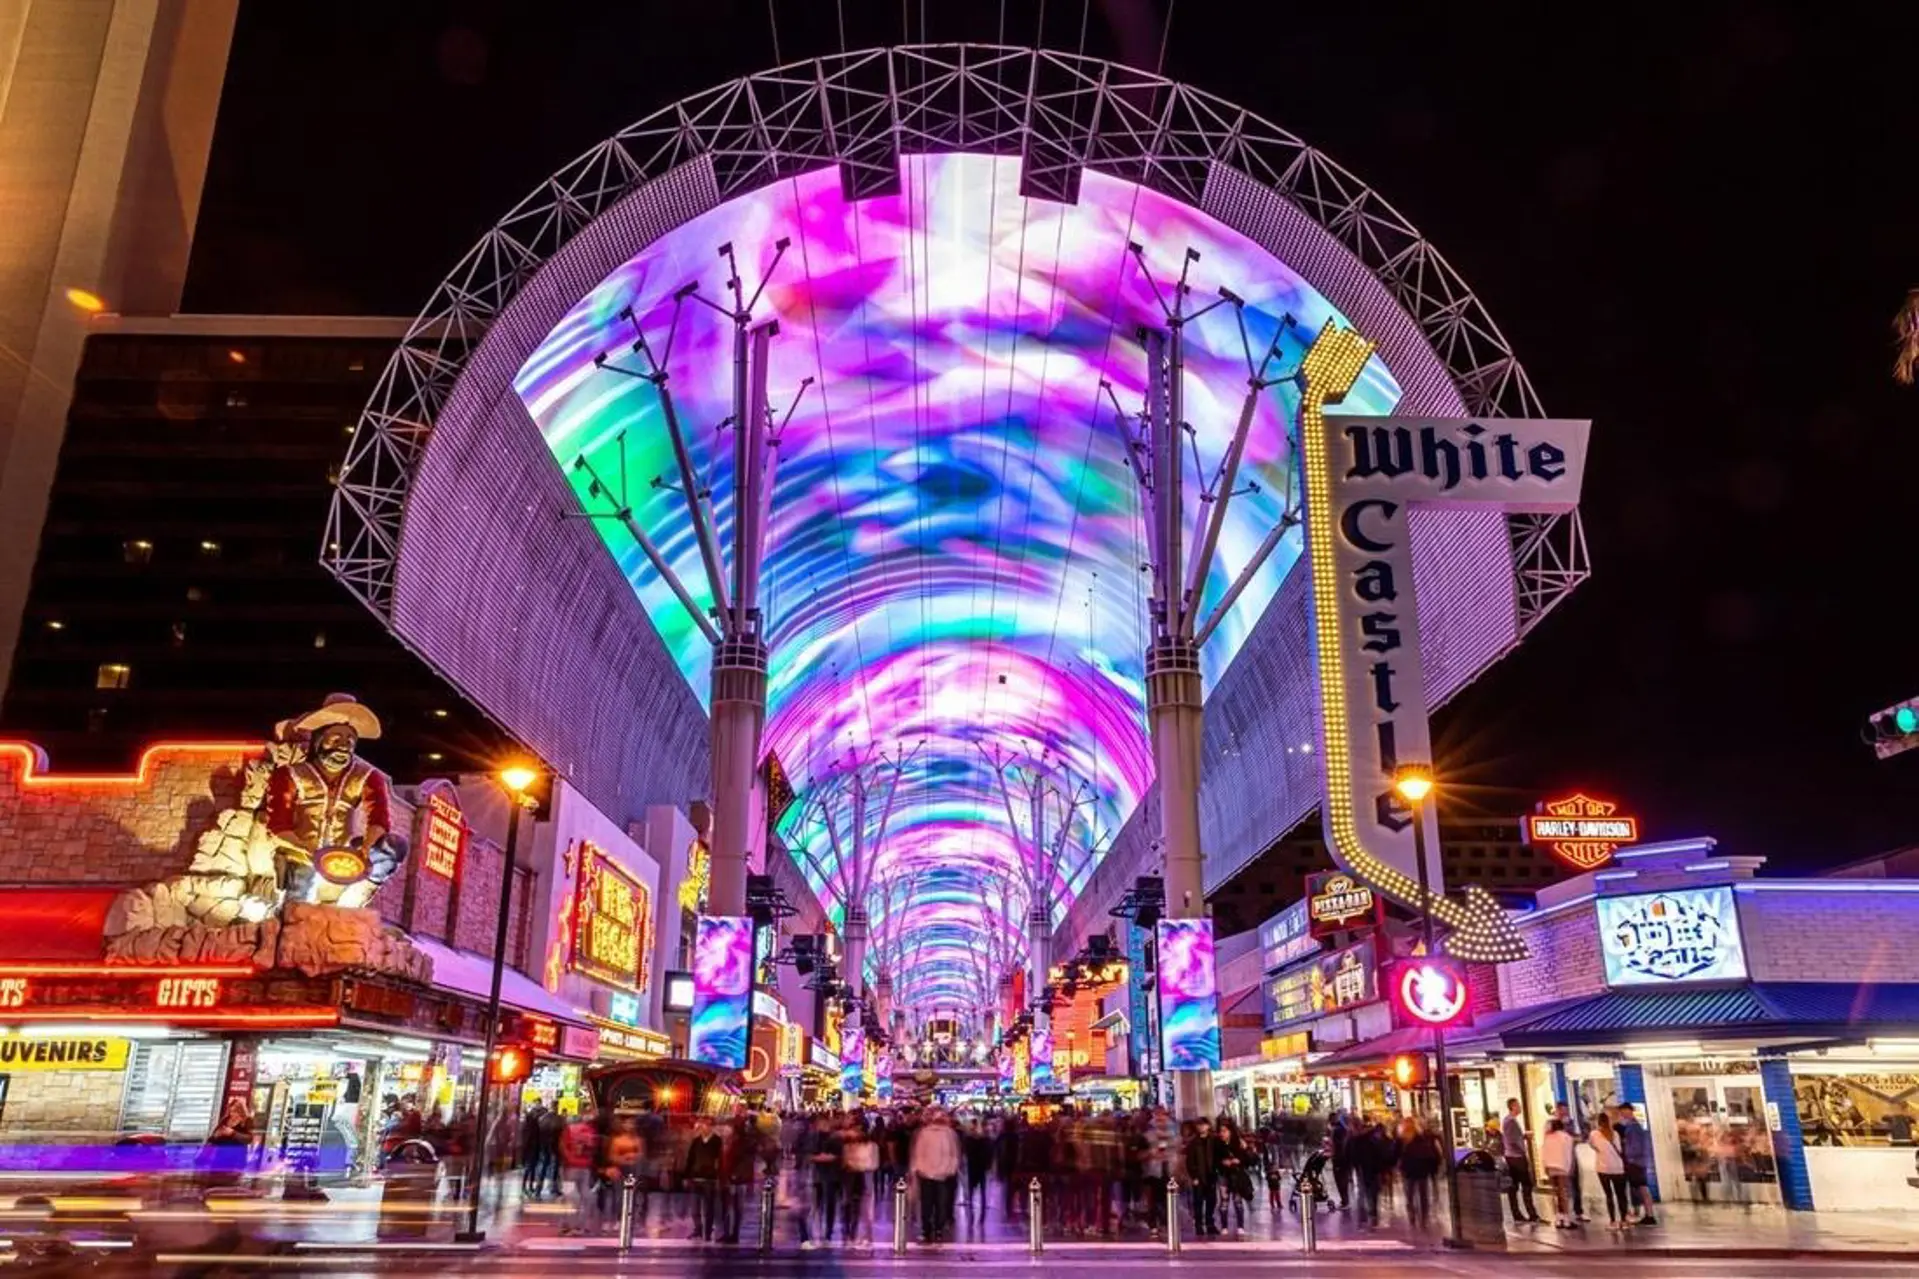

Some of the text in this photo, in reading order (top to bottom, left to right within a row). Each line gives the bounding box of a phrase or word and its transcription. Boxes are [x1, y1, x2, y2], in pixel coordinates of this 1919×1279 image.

[1344, 423, 1565, 492] White
[1340, 499, 1413, 833] Castle
[1556, 799, 1606, 816] MOTOR
[1536, 821, 1630, 837] HARLEY-DAVIDSON
[157, 979, 219, 1007] GIFTS
